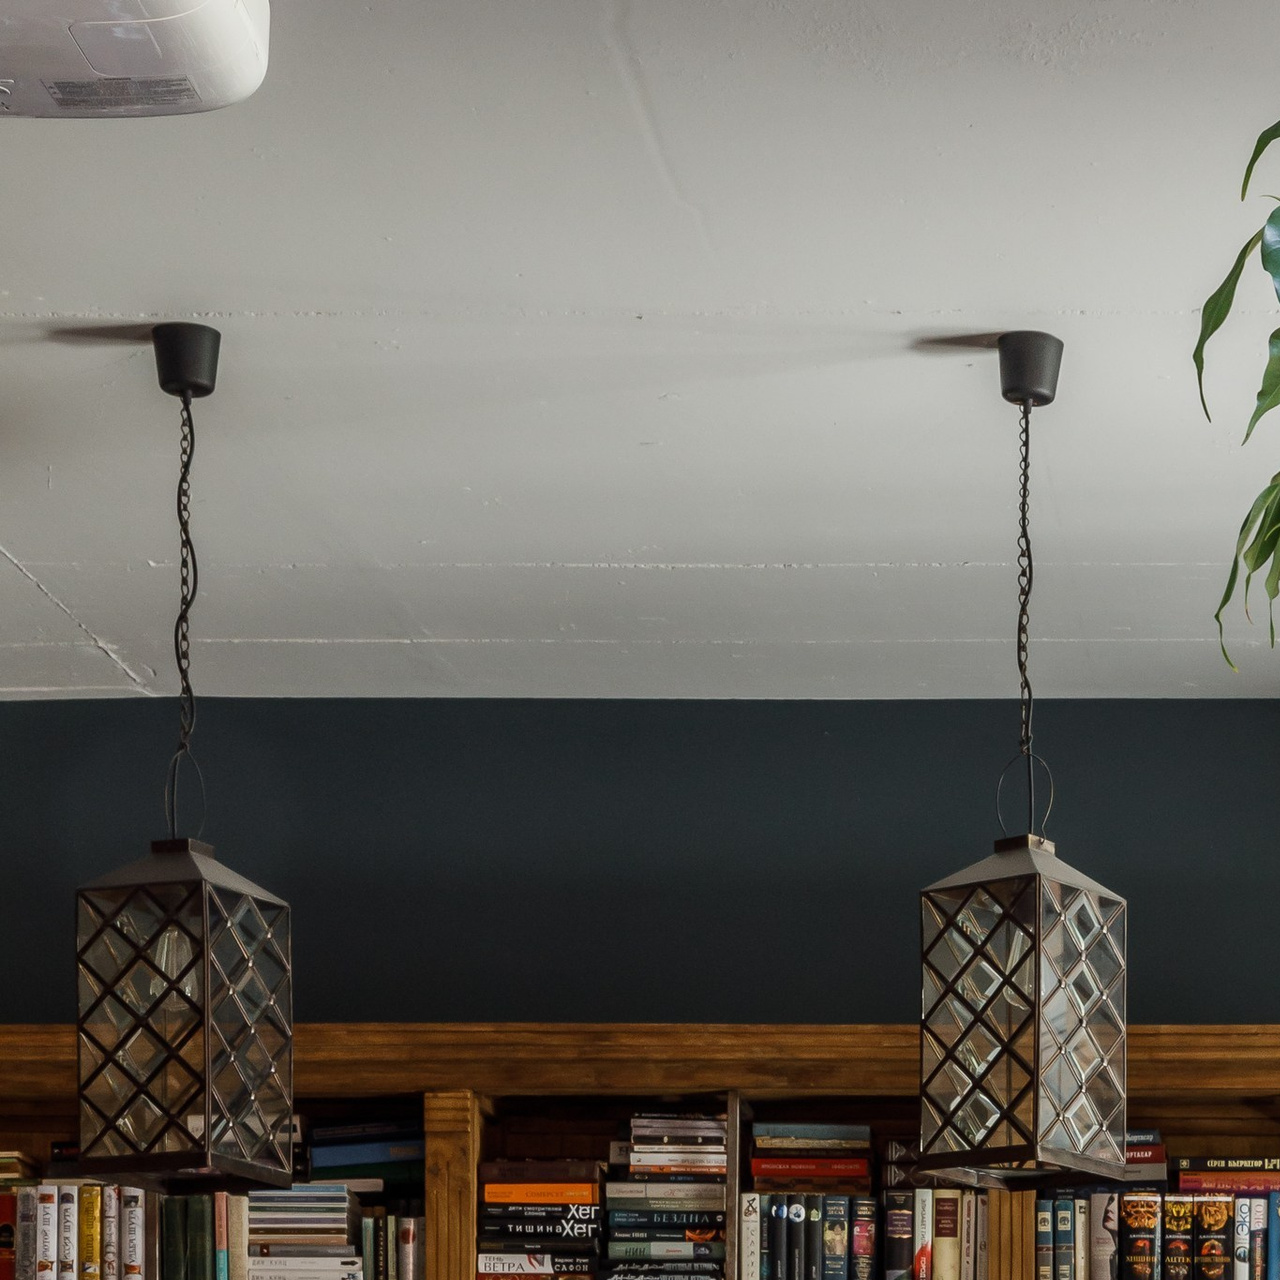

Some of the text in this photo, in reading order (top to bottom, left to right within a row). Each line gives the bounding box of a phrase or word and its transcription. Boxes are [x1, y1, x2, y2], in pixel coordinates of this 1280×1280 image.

[653, 1213, 710, 1223] БЕЗДНА
[508, 1224, 562, 1233] тишина
[484, 1262, 525, 1272] ВЕТРА
[919, 1256, 927, 1278] ГОРОД
